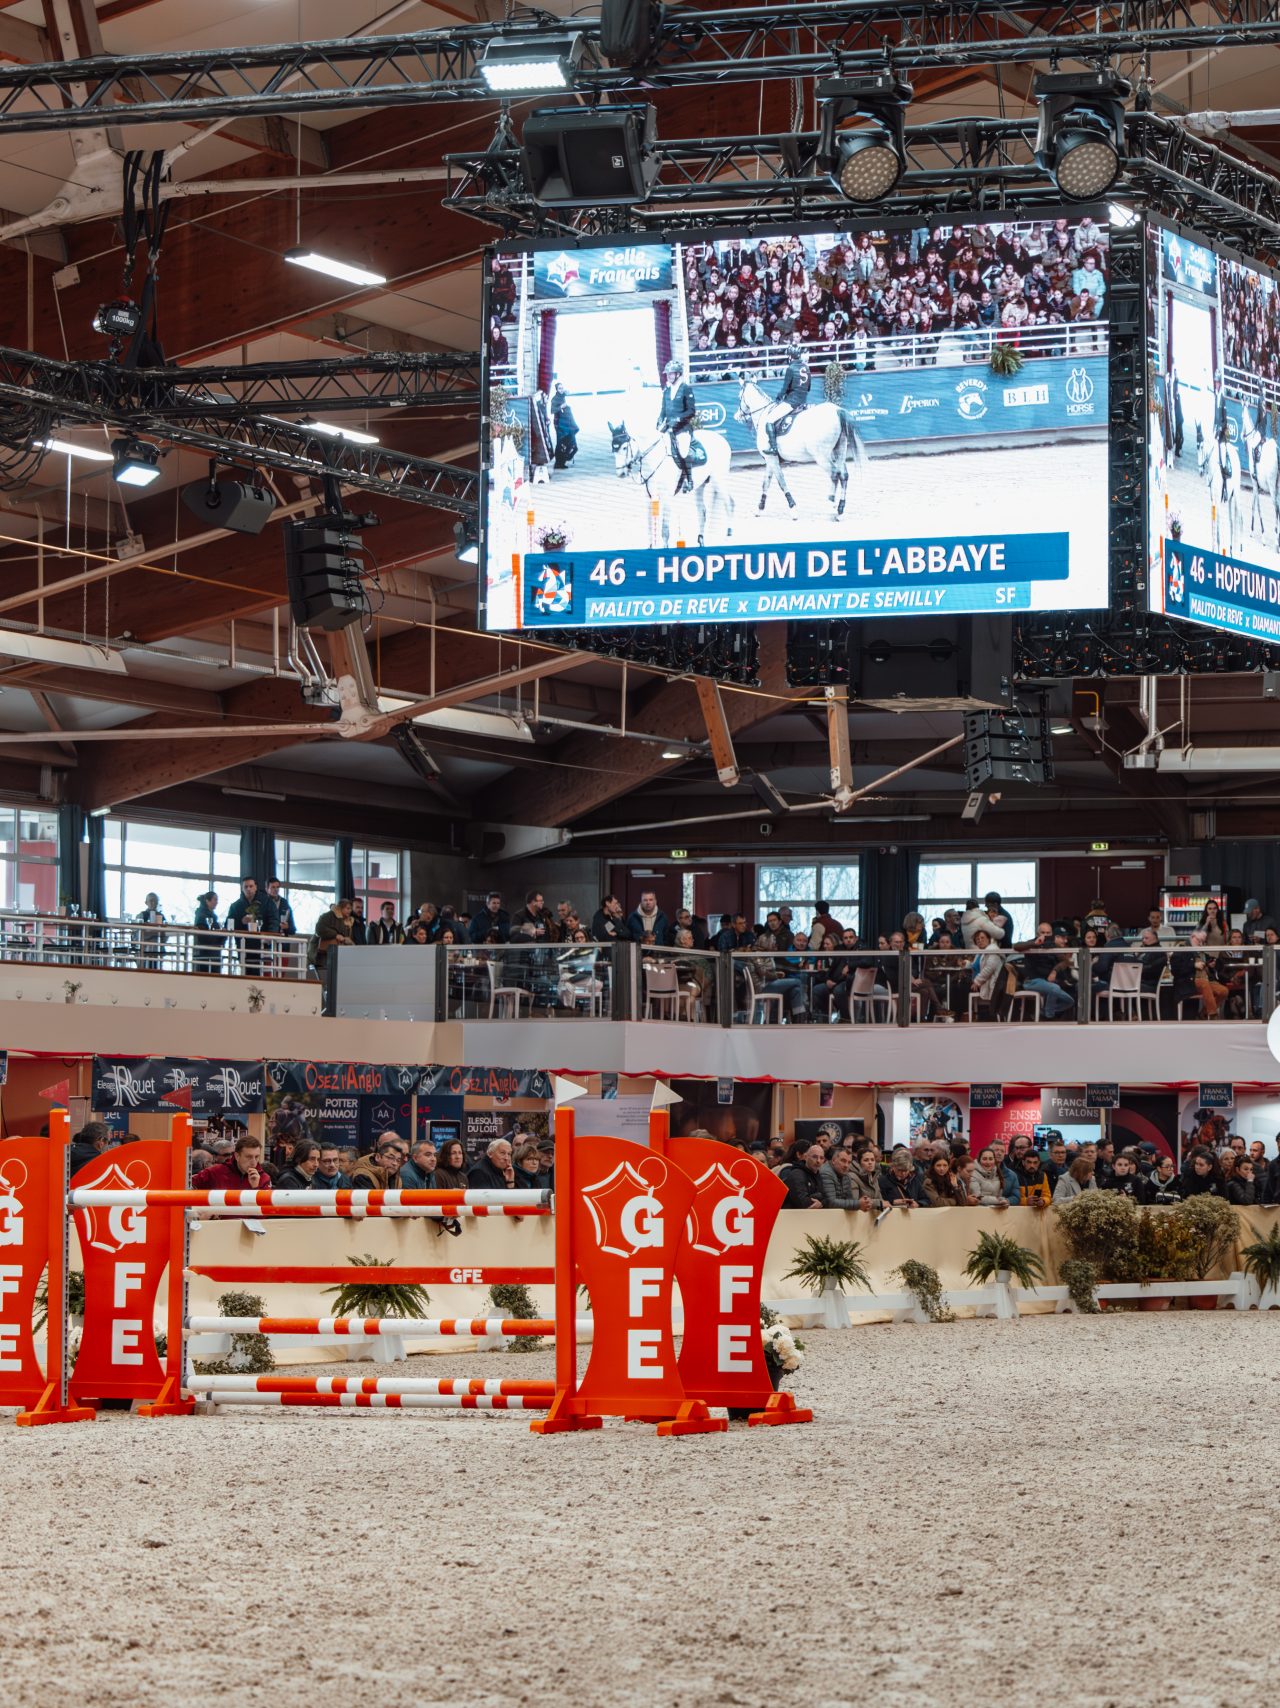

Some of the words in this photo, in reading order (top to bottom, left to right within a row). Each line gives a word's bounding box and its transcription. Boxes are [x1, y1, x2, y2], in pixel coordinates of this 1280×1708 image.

[603, 248, 646, 267] Selle
[111, 314, 135, 327] 1000kg
[589, 558, 626, 586] 46
[657, 551, 796, 584] HOPTUM
[807, 549, 848, 578] DE
[857, 543, 1006, 576] L'ABBAYE
[1190, 555, 1205, 585] 46
[1215, 561, 1266, 602] HOPTUM
[589, 600, 655, 618] MALITO
[657, 599, 681, 616] DE
[687, 597, 730, 615] REVE
[757, 593, 843, 612] DIAMANT
[846, 592, 872, 609] DE
[874, 589, 947, 608] SEMILLY
[995, 587, 1016, 604] SF
[1190, 598, 1217, 619] MALITO
[1216, 607, 1226, 622] DE
[1227, 609, 1243, 626] REVE
[111, 1065, 156, 1107] Rouet
[219, 1067, 262, 1108] Rouet
[325, 1098, 358, 1109] POTTER
[304, 1108, 317, 1118] DU
[318, 1108, 358, 1119] MANAOU
[377, 1109, 390, 1119] AA
[467, 1116, 503, 1125] ILESQUES
[1058, 1107, 1099, 1118] ÉTALONS
[467, 1125, 478, 1133] DU
[480, 1125, 498, 1133] LOIR
[450, 1268, 484, 1284] GFE
